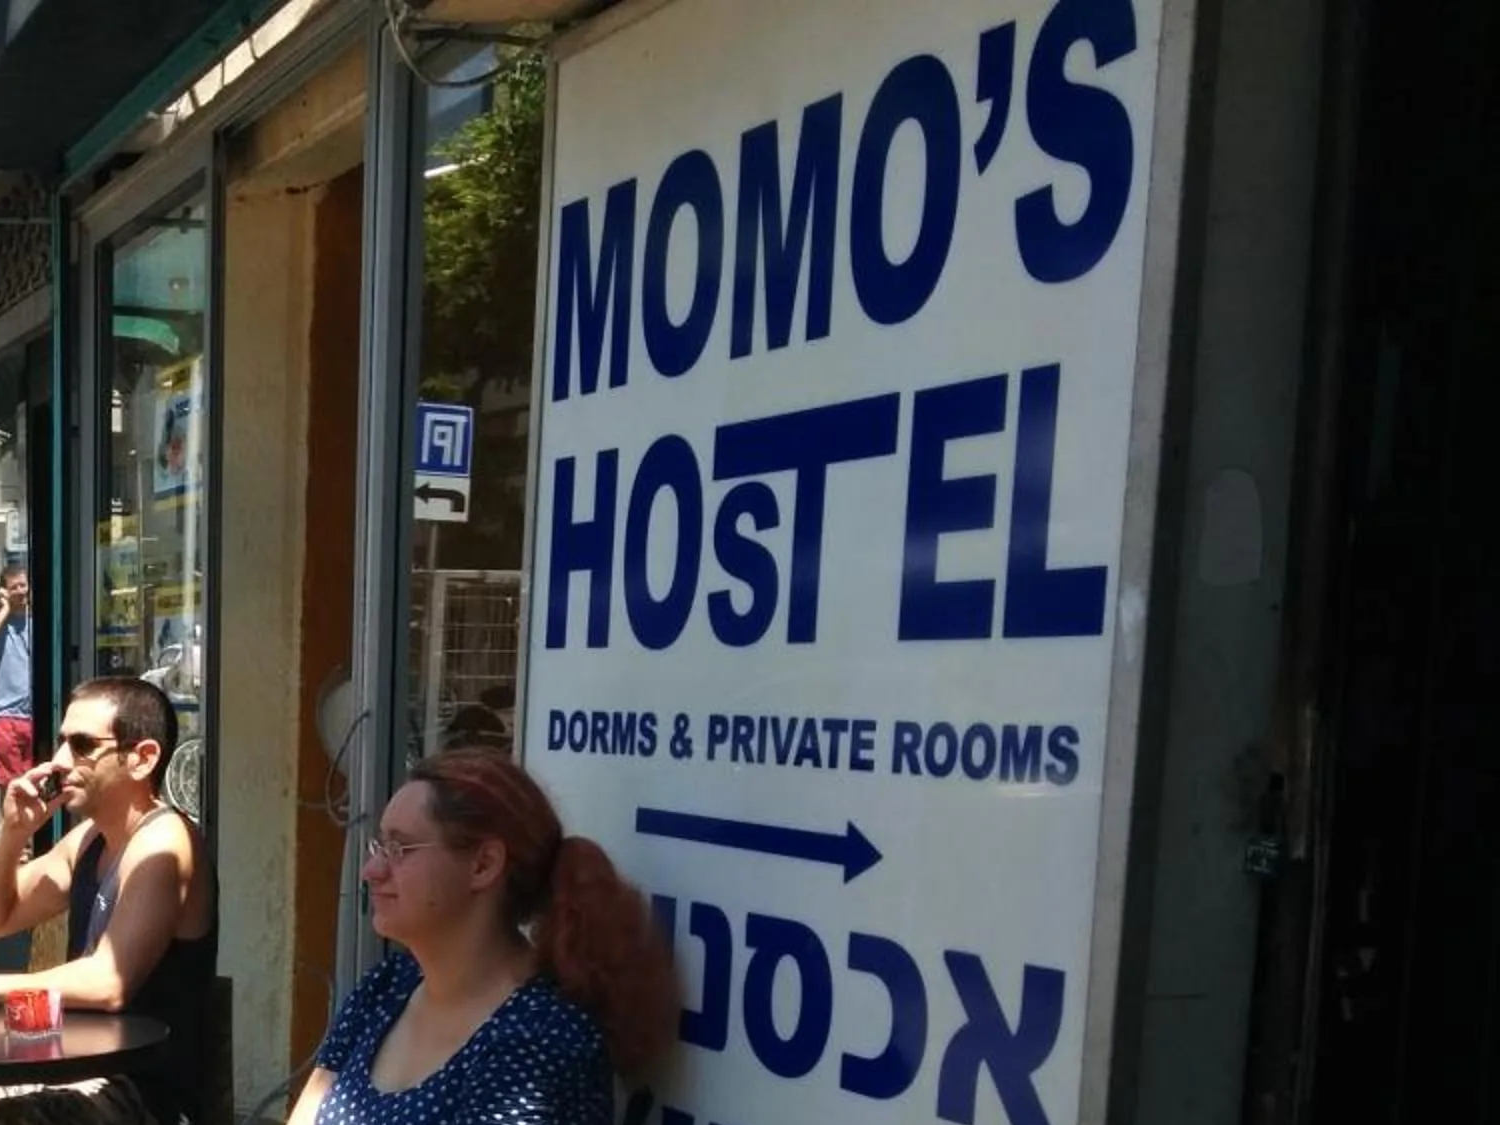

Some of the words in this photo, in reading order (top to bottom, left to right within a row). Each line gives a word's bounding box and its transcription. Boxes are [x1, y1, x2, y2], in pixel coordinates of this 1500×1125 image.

[552, 0, 1138, 403] MOMO'S
[545, 362, 1109, 652] HOSTEL
[547, 708, 659, 759] DORMS
[668, 711, 695, 762] &
[704, 712, 878, 774] PRIVATE
[890, 719, 1081, 787] ROOMS
